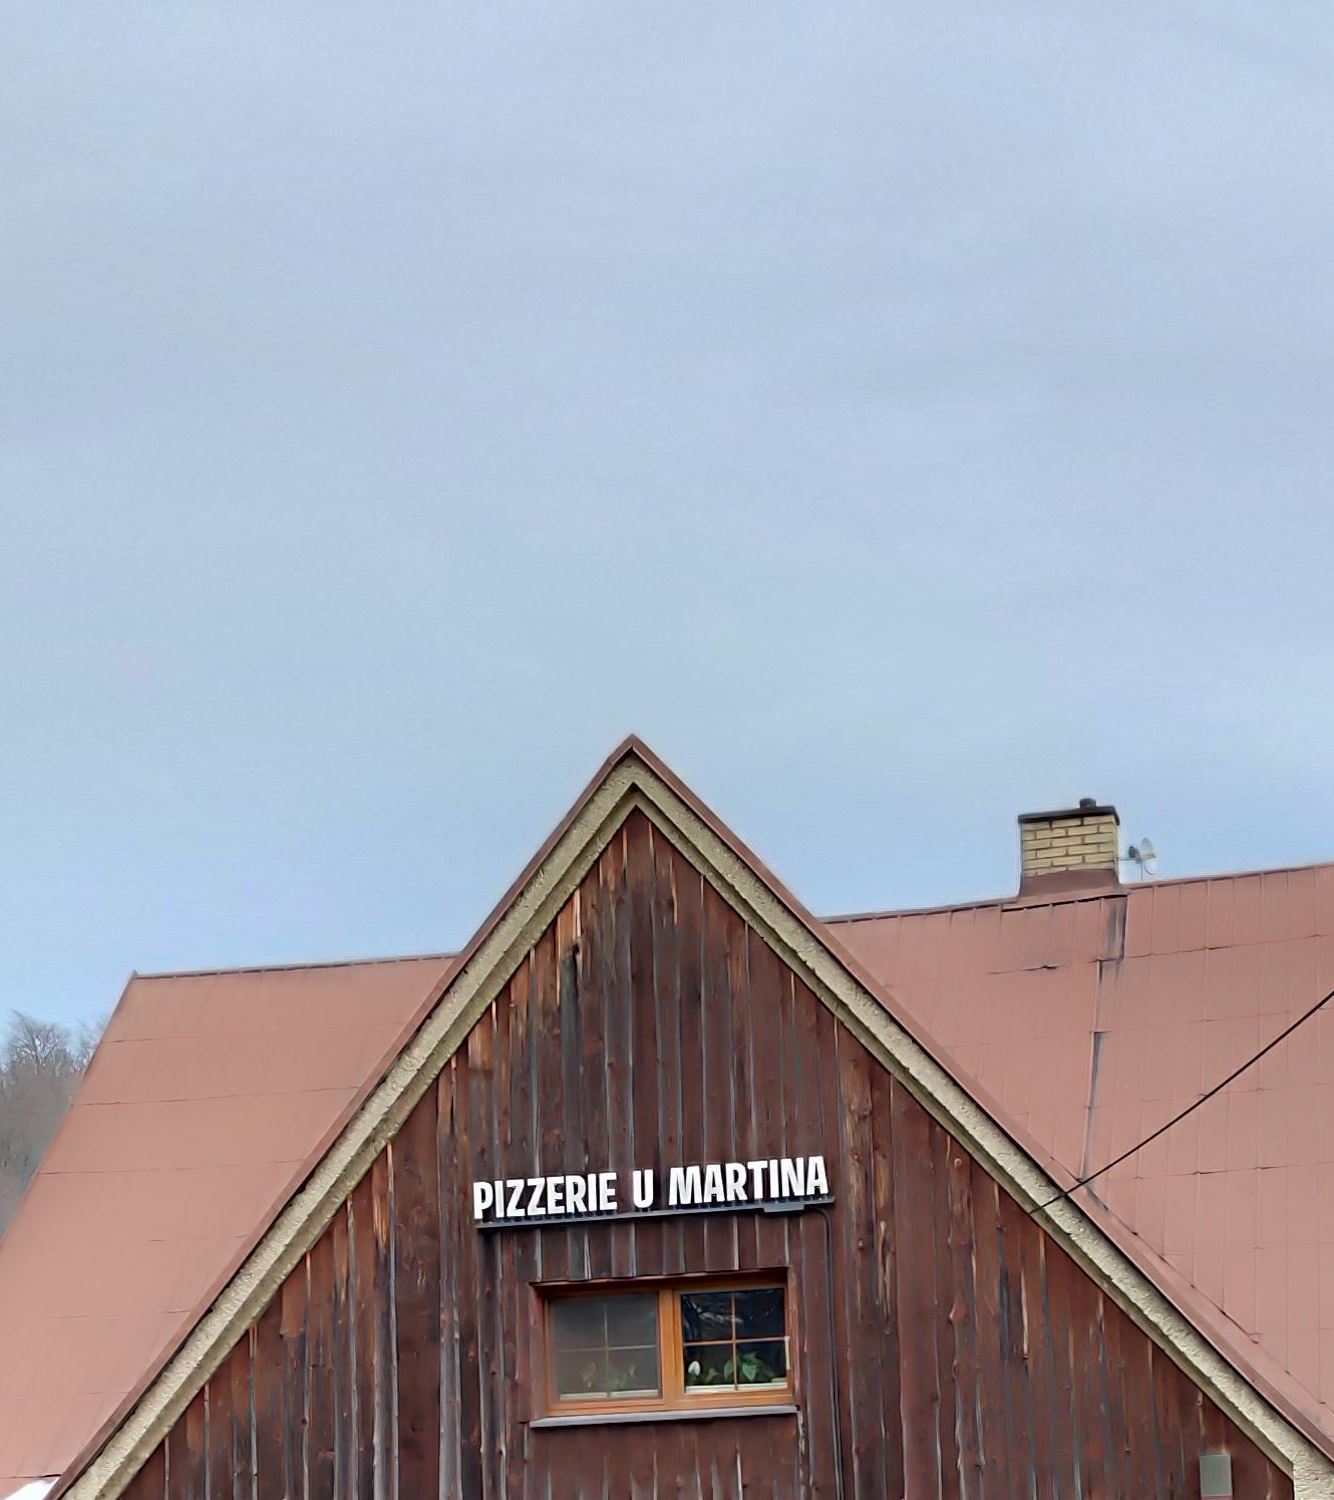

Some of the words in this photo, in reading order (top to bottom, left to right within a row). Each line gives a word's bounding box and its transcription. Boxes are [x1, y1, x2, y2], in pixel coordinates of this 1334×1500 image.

[473, 1172, 617, 1219] PIZZERIE
[632, 1169, 654, 1208] U
[669, 1155, 829, 1206] MARTINA
